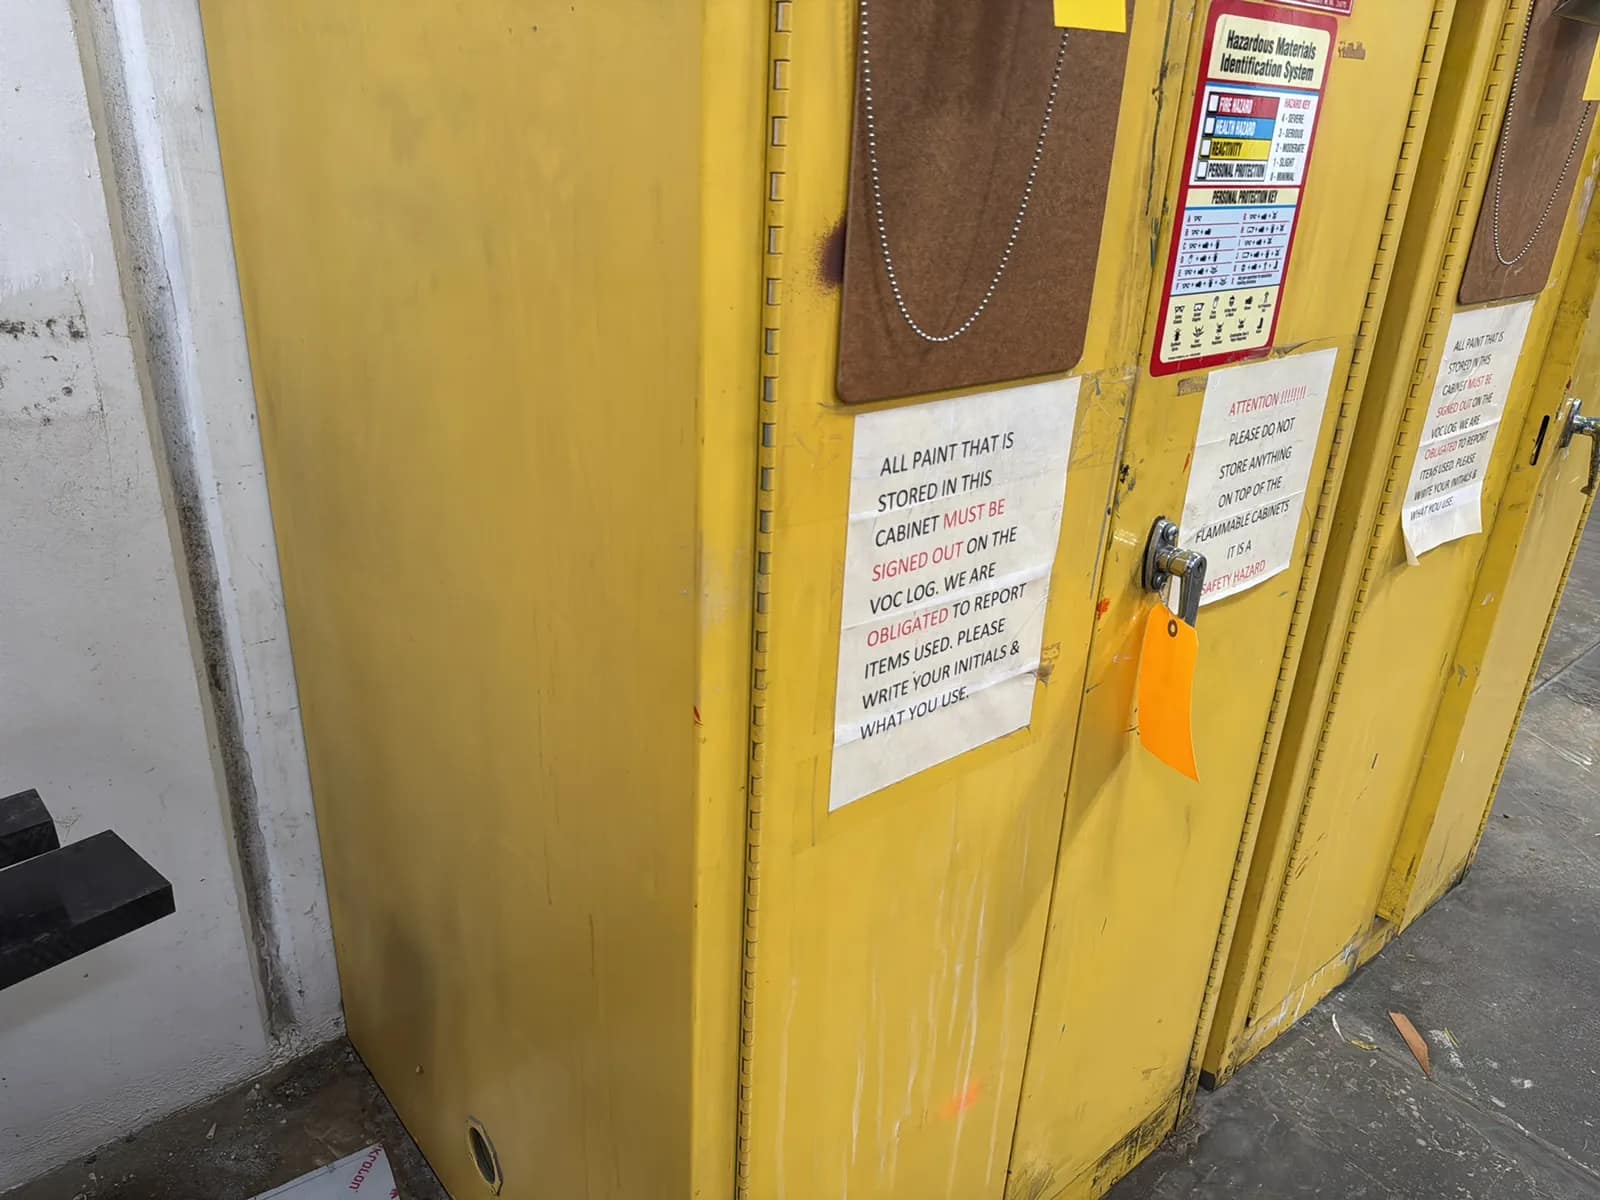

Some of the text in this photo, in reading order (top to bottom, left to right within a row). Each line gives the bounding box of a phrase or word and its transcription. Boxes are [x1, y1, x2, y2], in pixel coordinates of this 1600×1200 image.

[1226, 30, 1316, 60] Hazardous Materials
[1220, 53, 1314, 83] Identification System
[1219, 97, 1253, 114] FIRE HAZARD
[1215, 119, 1256, 136] HEALTH HAZARD
[1211, 141, 1243, 157] REACTIVITY
[1208, 162, 1265, 178] PERSONAL PROTECTION
[1211, 190, 1278, 205] PERSONAL PROTECTION KEY
[1453, 340, 1465, 352] ALL
[1465, 336, 1485, 350] PAINT
[1485, 333, 1499, 345] THAT
[1448, 359, 1472, 374] STORED
[1479, 354, 1492, 367] THIS
[1442, 373, 1494, 396] CABINET MUST BE
[1228, 392, 1279, 417] ATTENTION
[1436, 392, 1494, 418] SIGNED OUT ON THE
[1229, 417, 1296, 446] PLEASE DO NOT
[1431, 425, 1445, 439] VOC
[1459, 417, 1470, 431] WE
[1469, 414, 1481, 427] ARE
[880, 431, 1014, 476] ALL PAINT THAT IS
[1424, 430, 1489, 460] OBLIGATED TO REPORT
[1219, 446, 1293, 480] STORE ANYTHING
[1419, 465, 1439, 480] ITEMS
[1456, 452, 1477, 468] PLEASE
[878, 470, 993, 513] STORED IN THIS
[1218, 475, 1283, 508] ON TOP OF THE
[1414, 485, 1434, 501] WRITE
[1434, 479, 1451, 493] YOUR
[1450, 470, 1473, 489] INITIALS
[875, 498, 1006, 547] CABINET MUST BE
[1195, 500, 1290, 544] FLAMMABLE CABINETS
[1410, 505, 1429, 521] WHAT
[1428, 501, 1441, 513] YOU
[872, 526, 1018, 582] SIGNED OUT ON THE
[1227, 539, 1252, 560] IT IS A
[869, 562, 997, 615] VOC LOG. WE ARE
[1201, 560, 1266, 597] SAFETY HAZARD
[867, 582, 1027, 648] OBLIGATED TO REPORT
[864, 618, 1006, 679] ITEMS USED. PLEASE
[862, 640, 1020, 710] WRITE YOUR INITIALS &
[860, 684, 970, 740] WHAT YOU USE.
